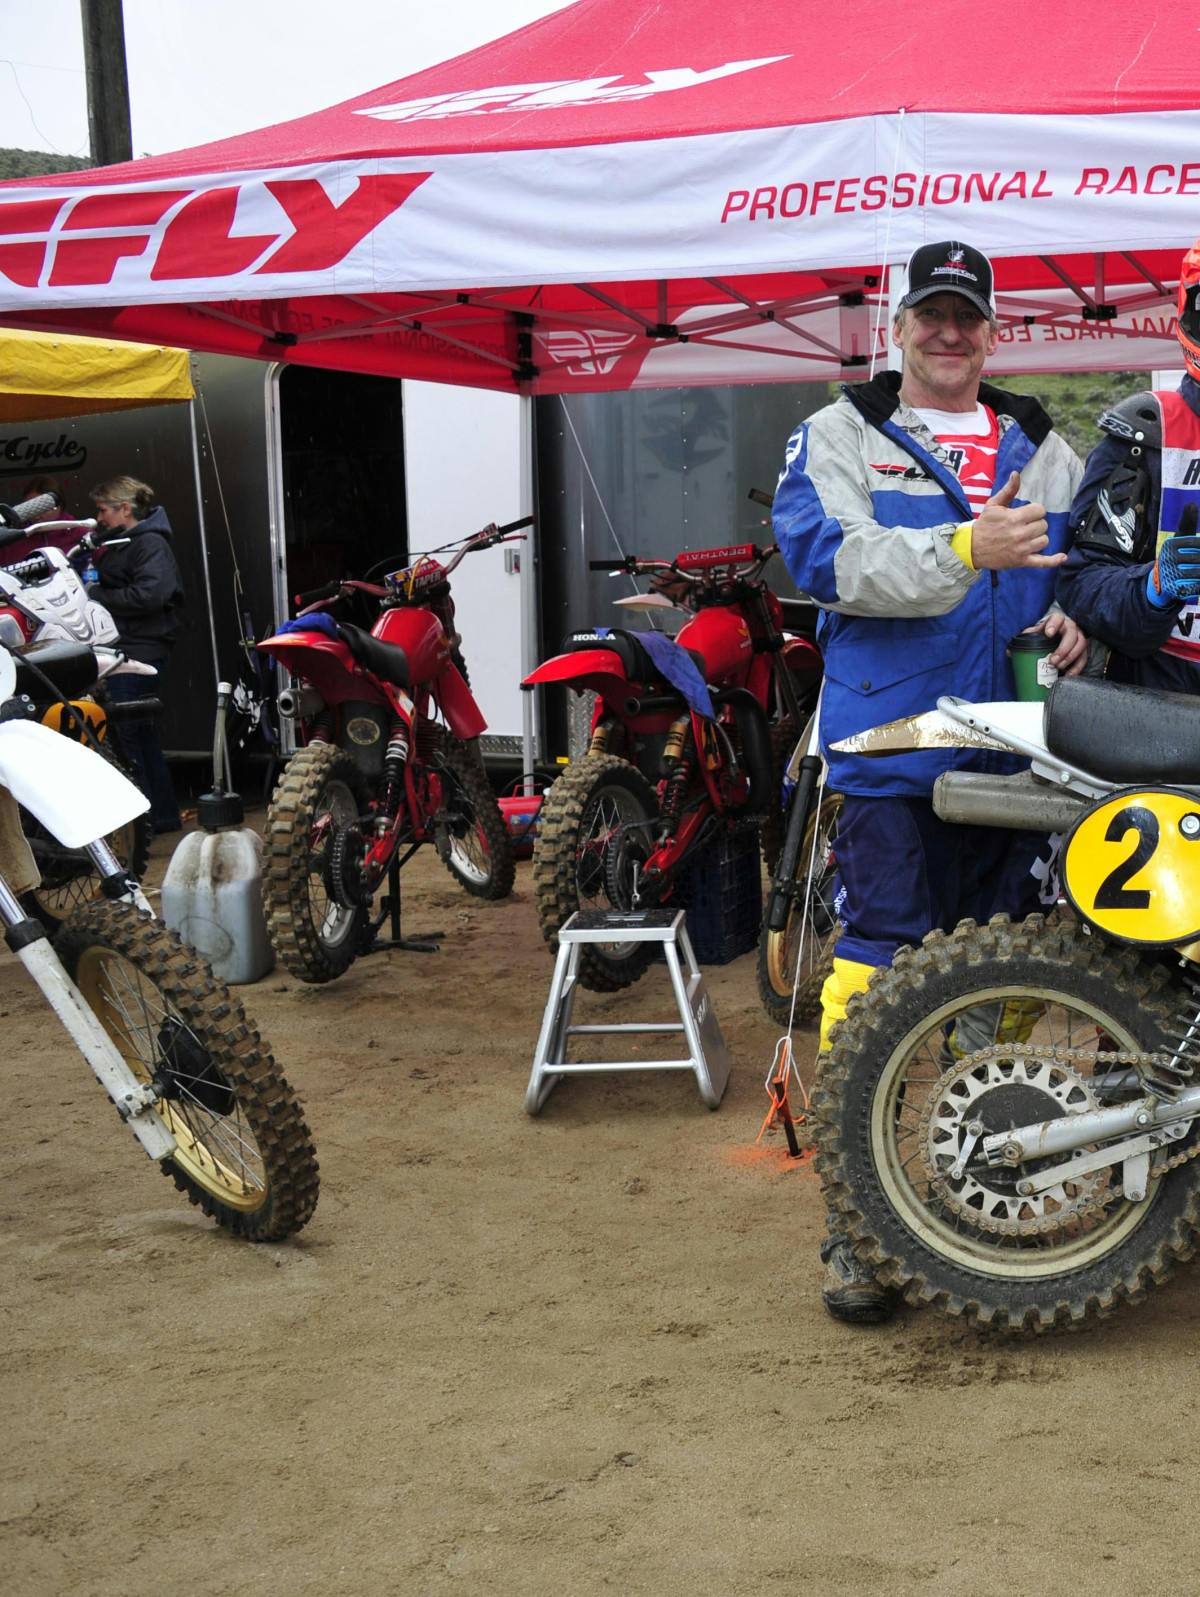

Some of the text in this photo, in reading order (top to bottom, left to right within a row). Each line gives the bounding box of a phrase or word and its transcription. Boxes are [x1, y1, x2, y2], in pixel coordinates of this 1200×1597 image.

[375, 54, 794, 120] FLY
[721, 170, 1053, 223] PROFESSIONAL
[25, 172, 434, 287] FLY
[5, 434, 80, 466] Cycle
[573, 633, 616, 641] HONA
[1093, 806, 1160, 909] 2
